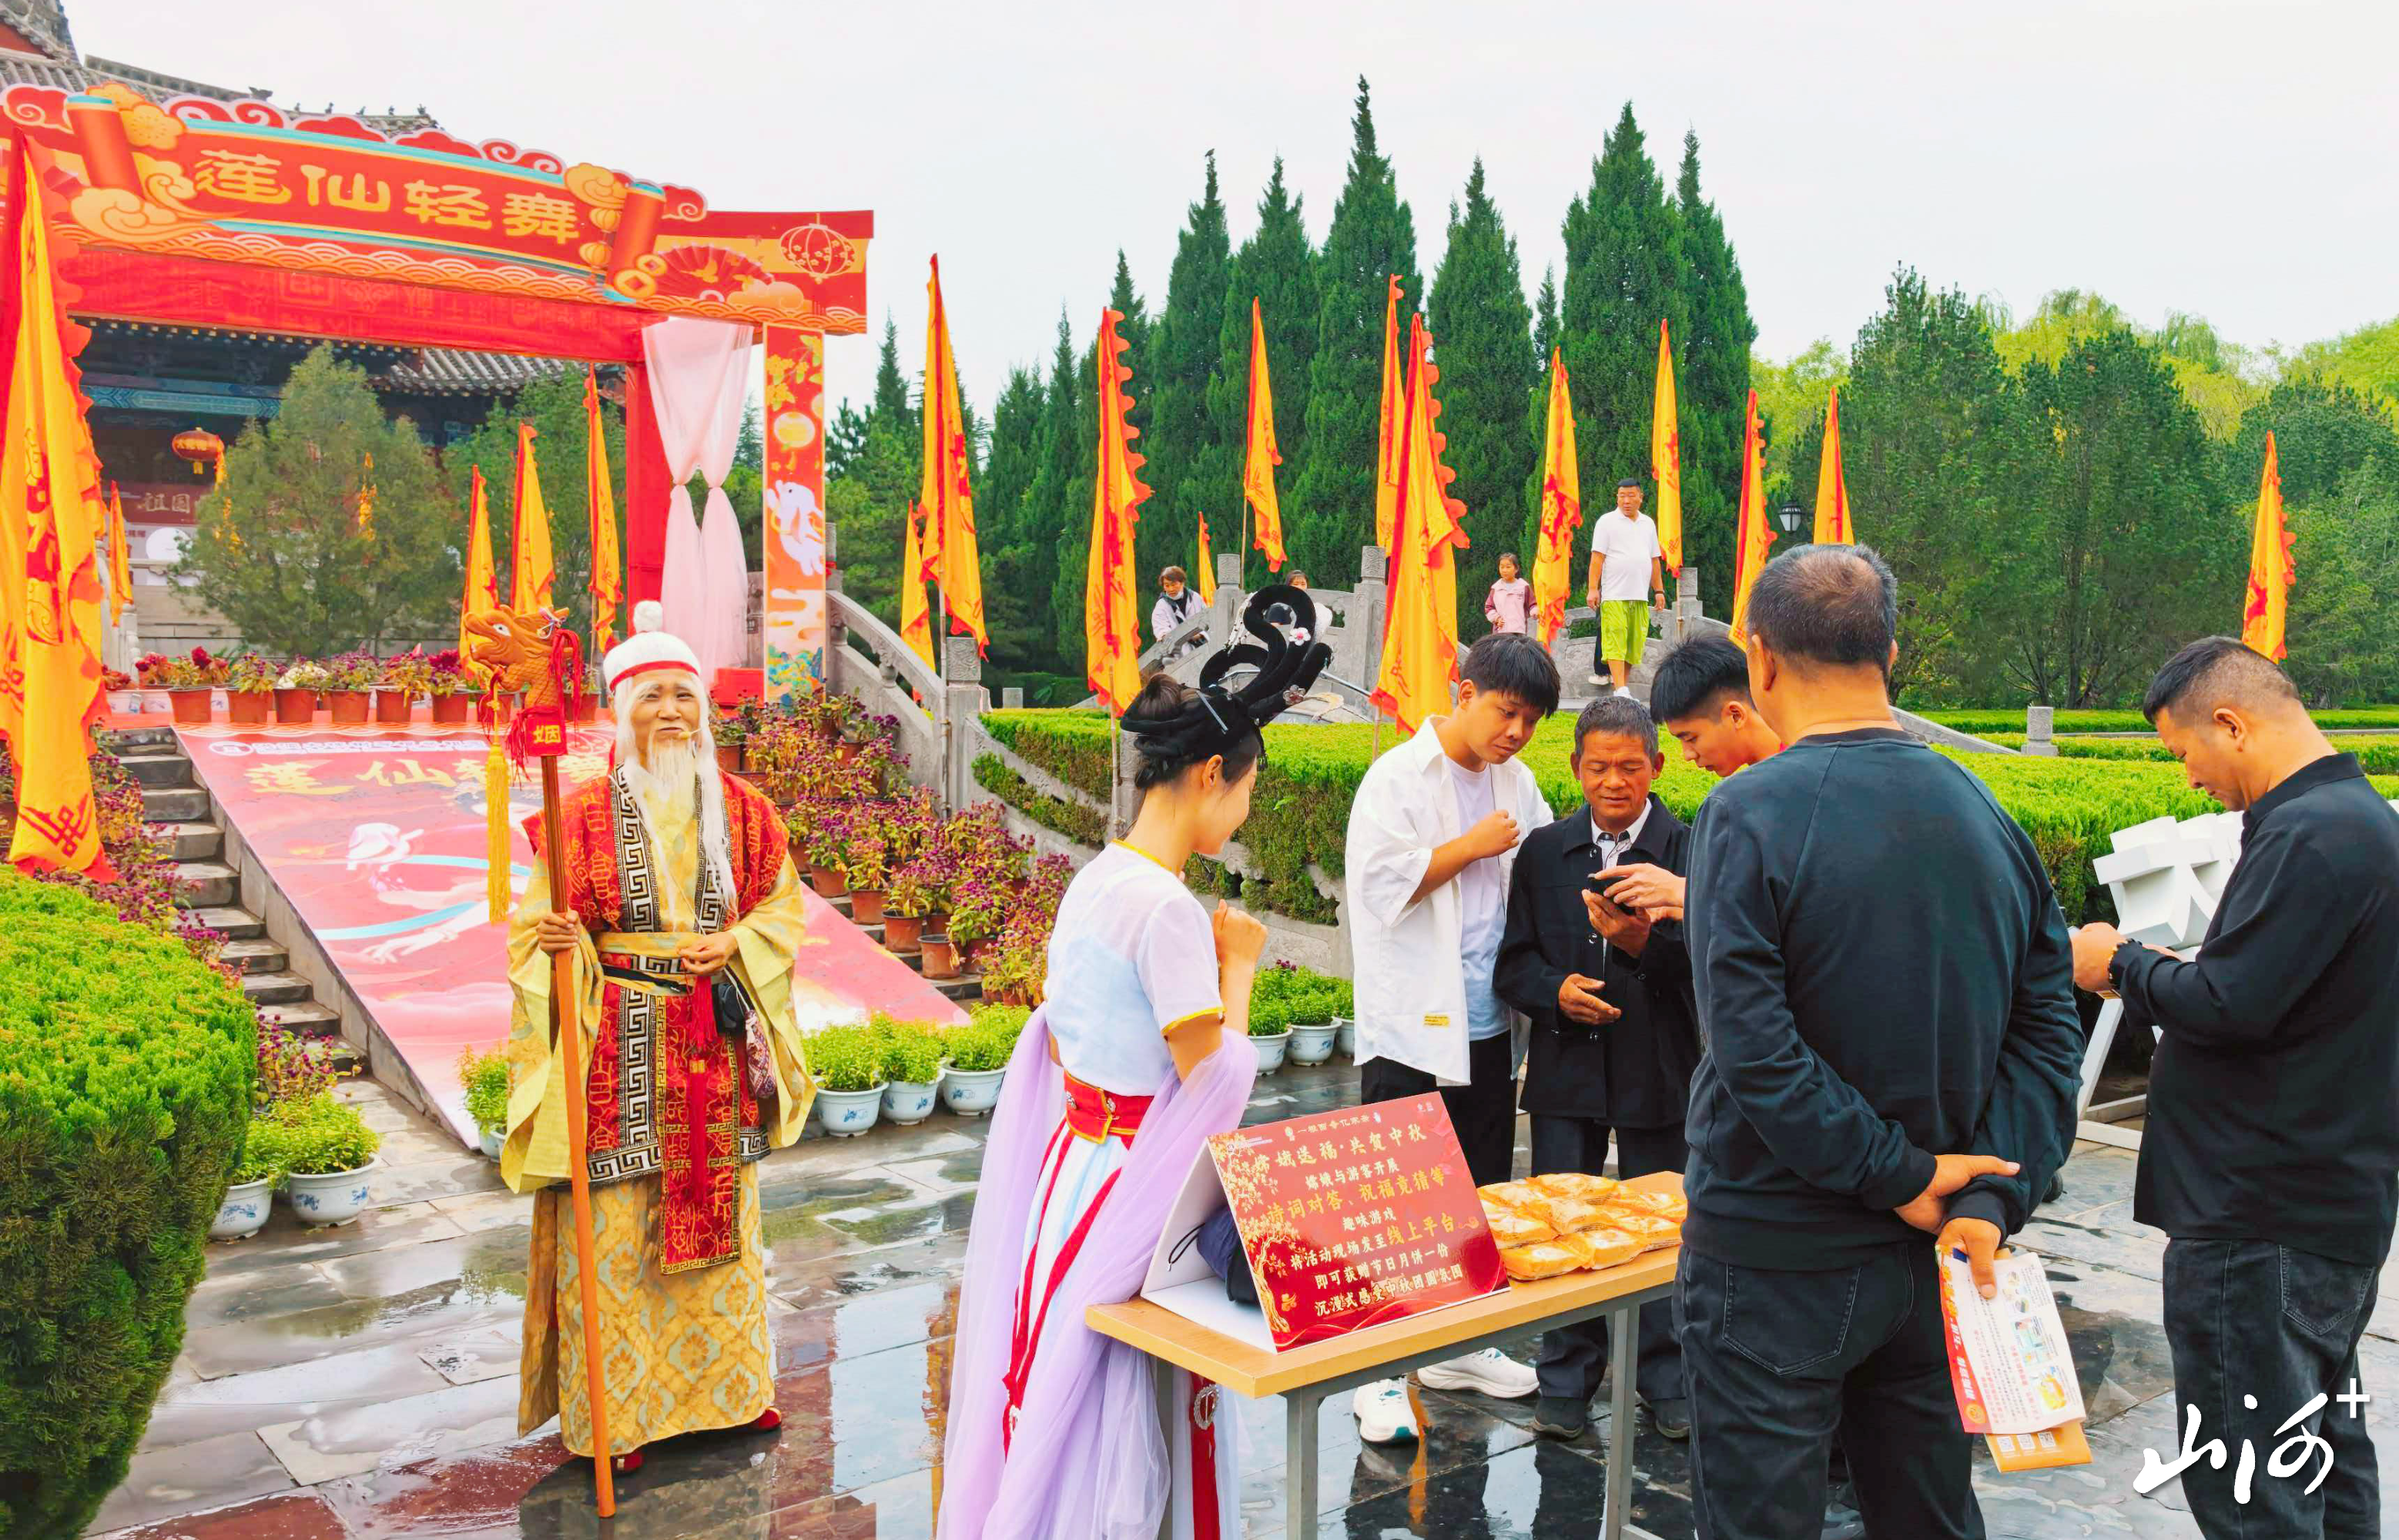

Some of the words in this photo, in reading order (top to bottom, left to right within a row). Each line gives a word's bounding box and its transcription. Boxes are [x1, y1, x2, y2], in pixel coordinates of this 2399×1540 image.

[196, 149, 580, 245] 莲仙轻舞
[533, 725, 561, 744] 姻
[1305, 1157, 1400, 1190] 嫦娥与游客开展
[1342, 1207, 1396, 1231] 趣味游戏
[1315, 1243, 1449, 1290] 即可获赠节日月饼一份
